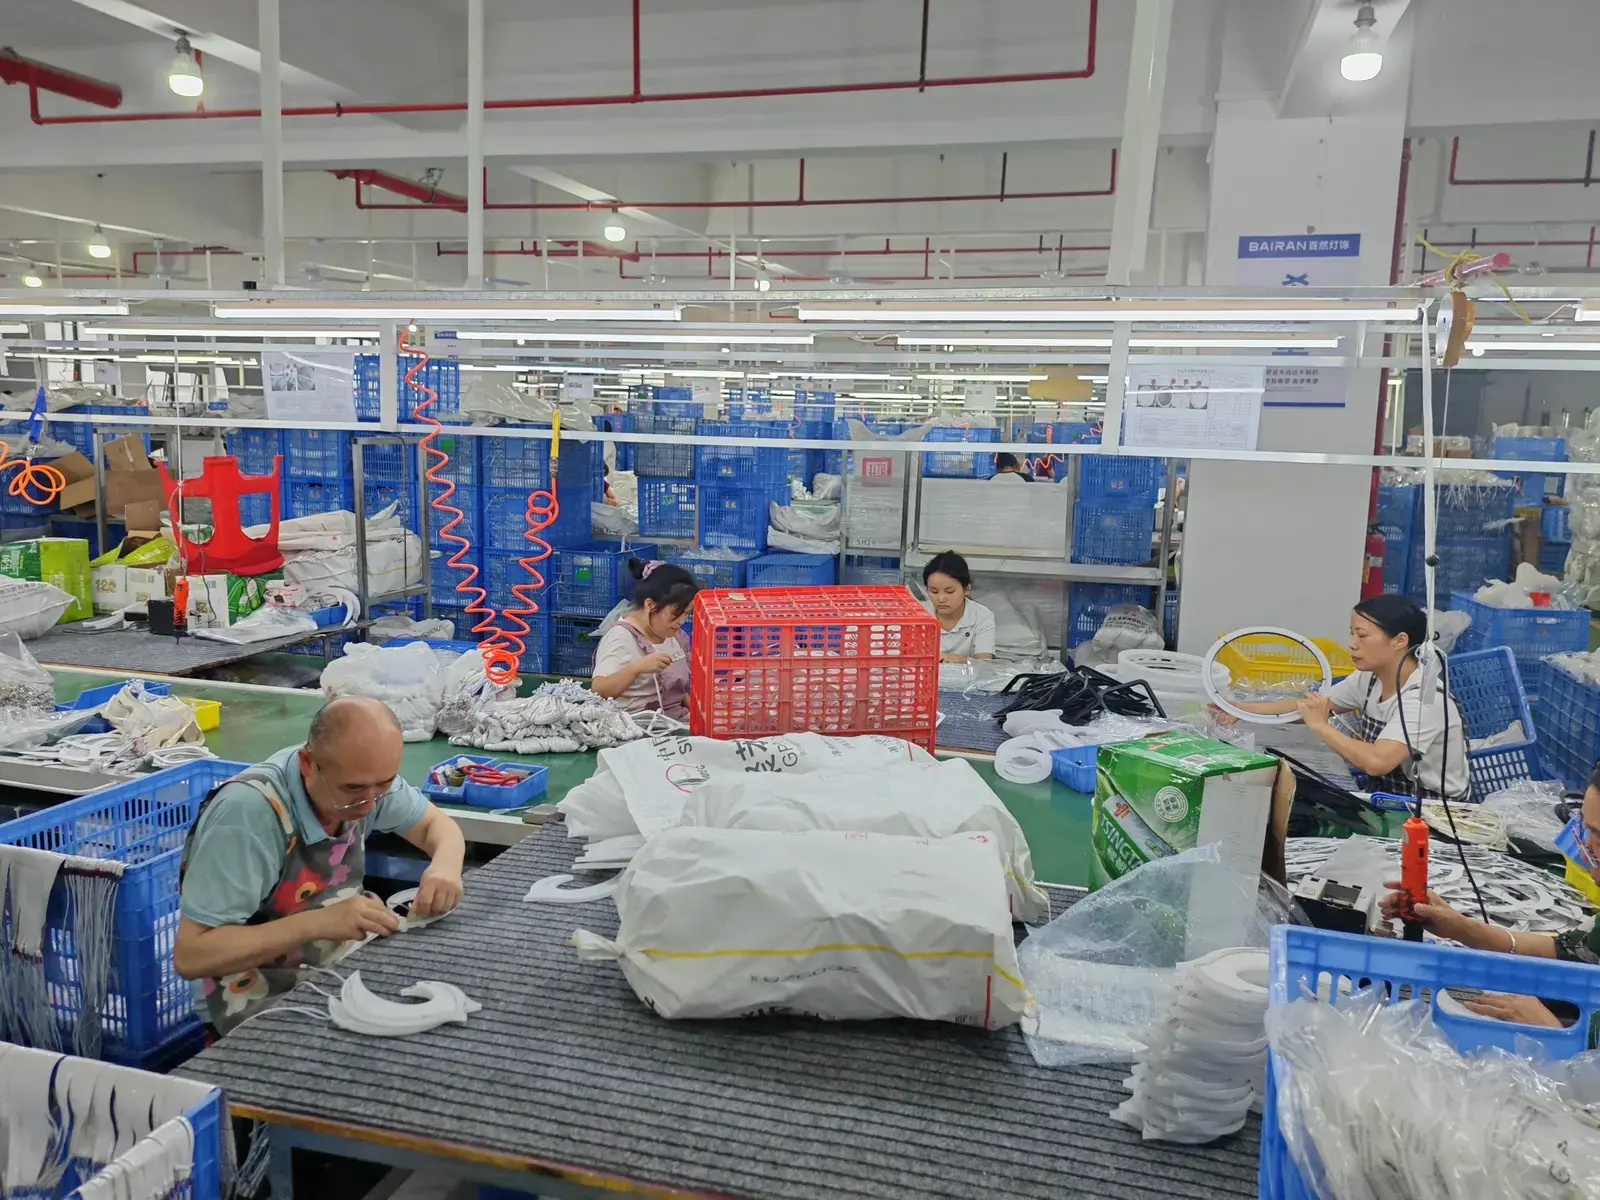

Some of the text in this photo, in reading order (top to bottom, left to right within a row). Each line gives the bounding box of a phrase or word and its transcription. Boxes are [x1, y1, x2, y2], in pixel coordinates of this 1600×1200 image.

[1248, 240, 1350, 252] BAIRAN 百然灯饰
